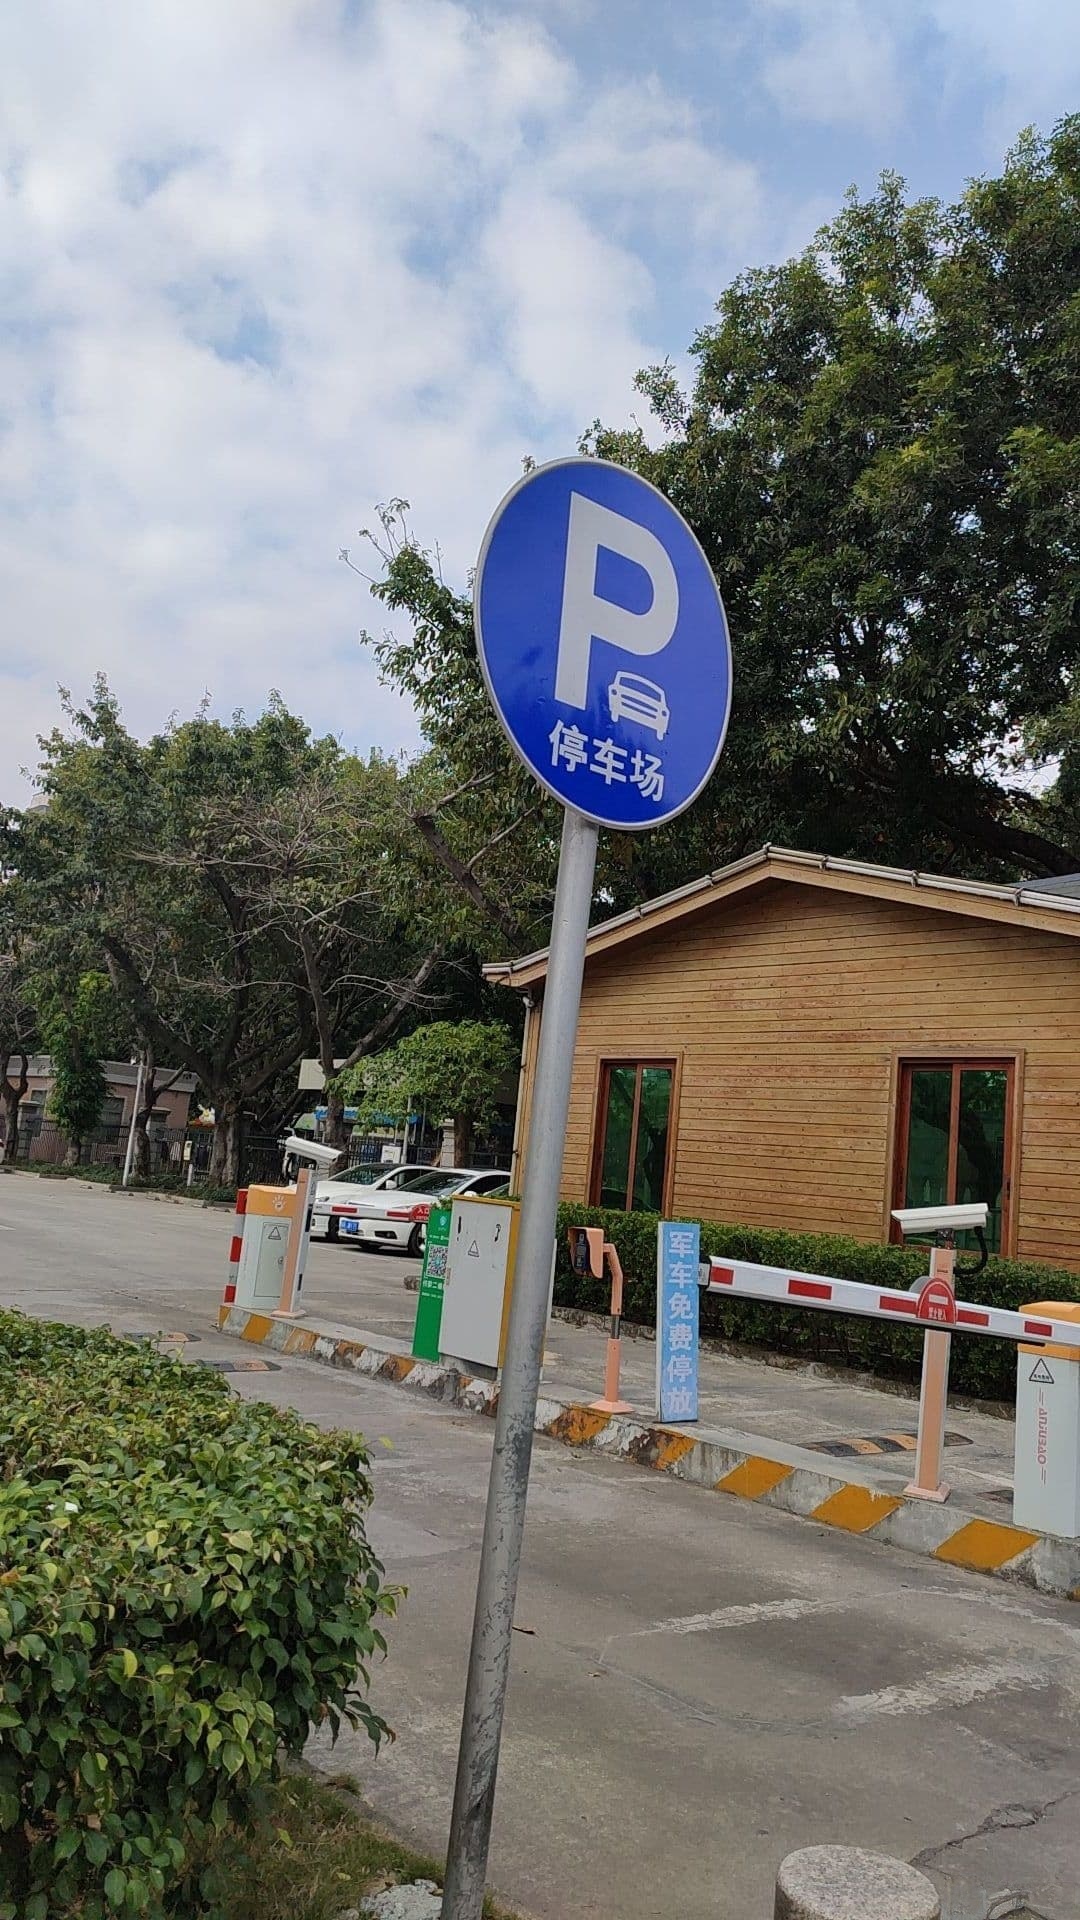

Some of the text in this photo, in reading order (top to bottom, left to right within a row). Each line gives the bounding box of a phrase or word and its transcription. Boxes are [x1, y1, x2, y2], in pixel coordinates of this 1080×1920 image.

[555, 491, 680, 711] P
[548, 719, 666, 803] 停车场
[667, 1230, 695, 1415] 军车免费停放
